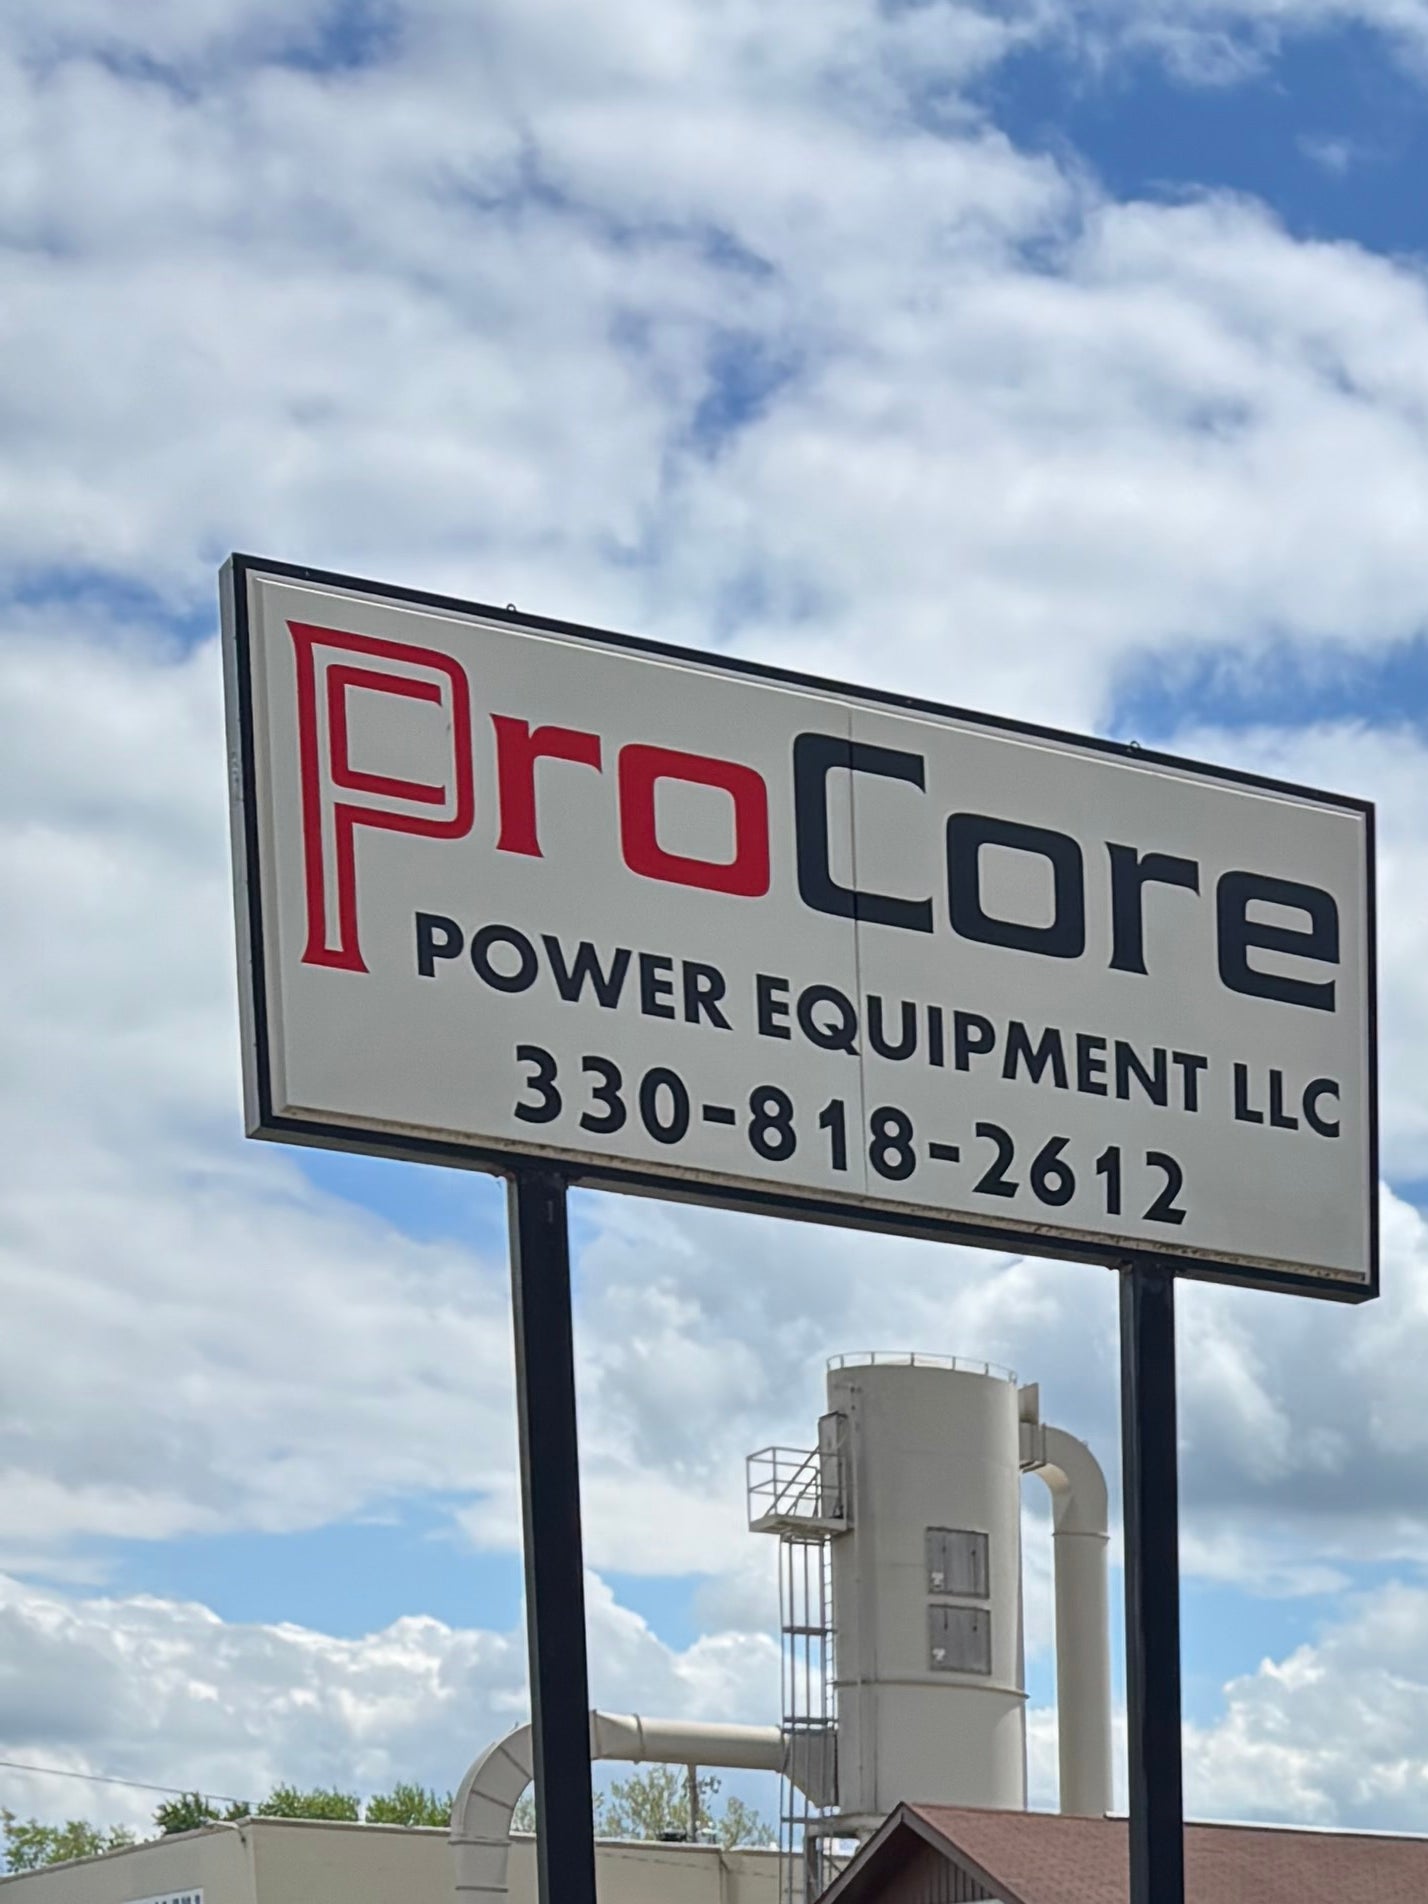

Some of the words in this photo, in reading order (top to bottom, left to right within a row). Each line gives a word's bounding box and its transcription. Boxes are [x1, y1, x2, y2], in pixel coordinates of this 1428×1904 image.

[286, 619, 1341, 1013] ProCore
[414, 911, 732, 1032] POWER
[756, 972, 1207, 1114] EQUIPMENT
[1233, 1060, 1341, 1140] LLC
[512, 1044, 1186, 1226] 330-818-2612
